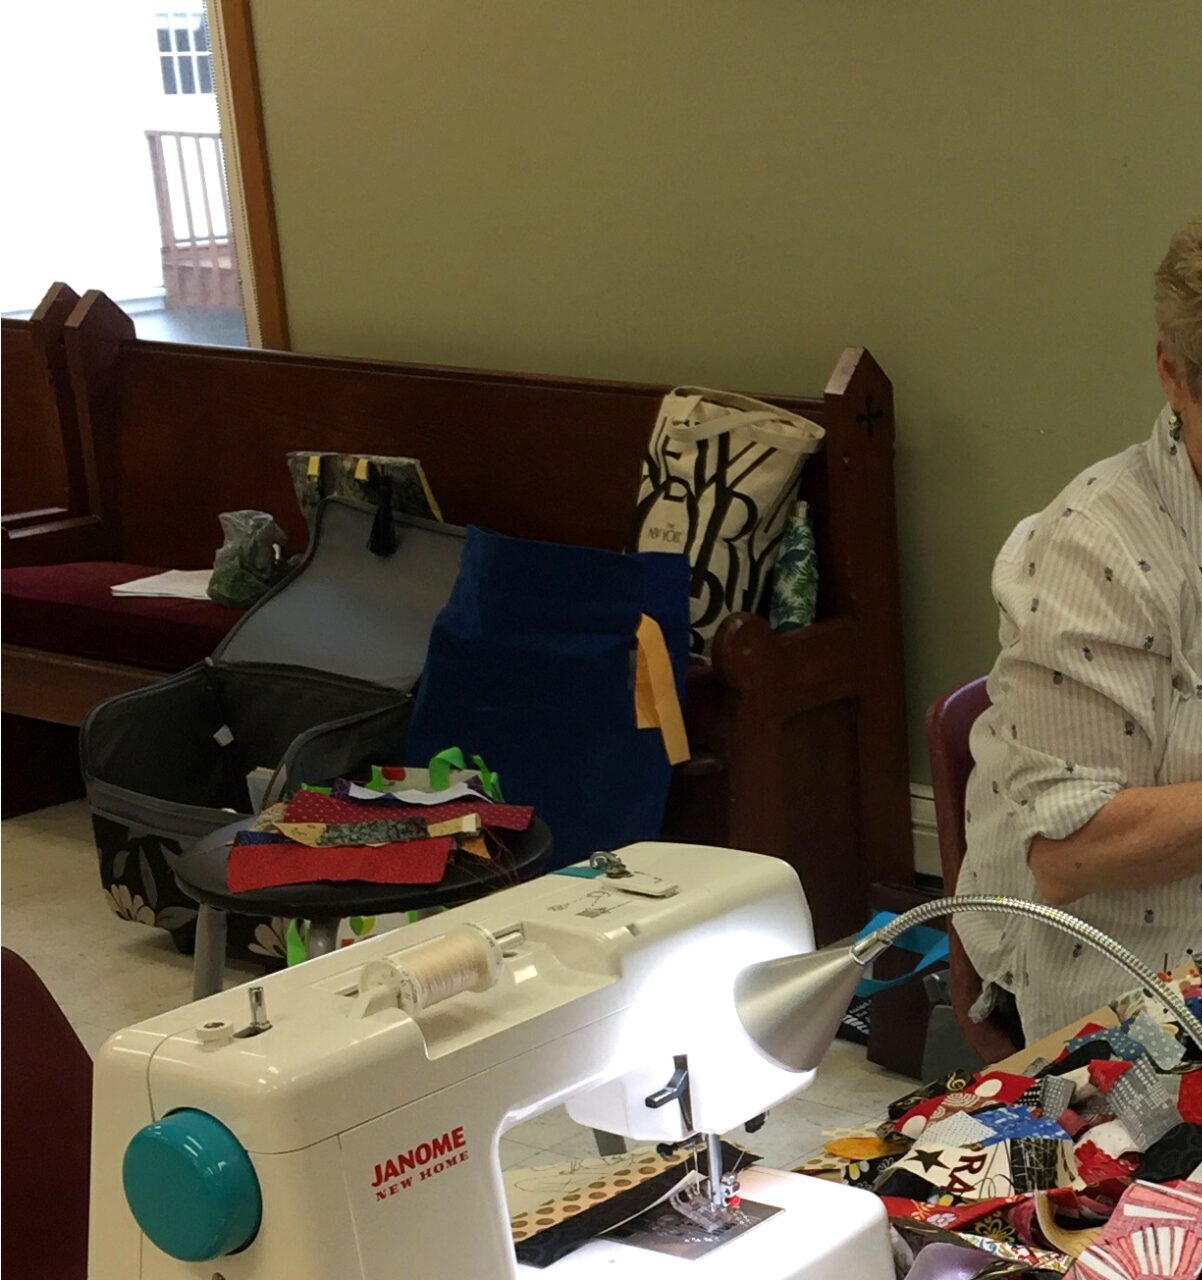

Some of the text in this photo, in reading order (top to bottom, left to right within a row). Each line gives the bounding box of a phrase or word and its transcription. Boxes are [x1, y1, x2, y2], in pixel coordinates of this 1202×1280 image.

[371, 1126, 467, 1188] JANOME
[375, 1150, 470, 1202] NEW HOME
